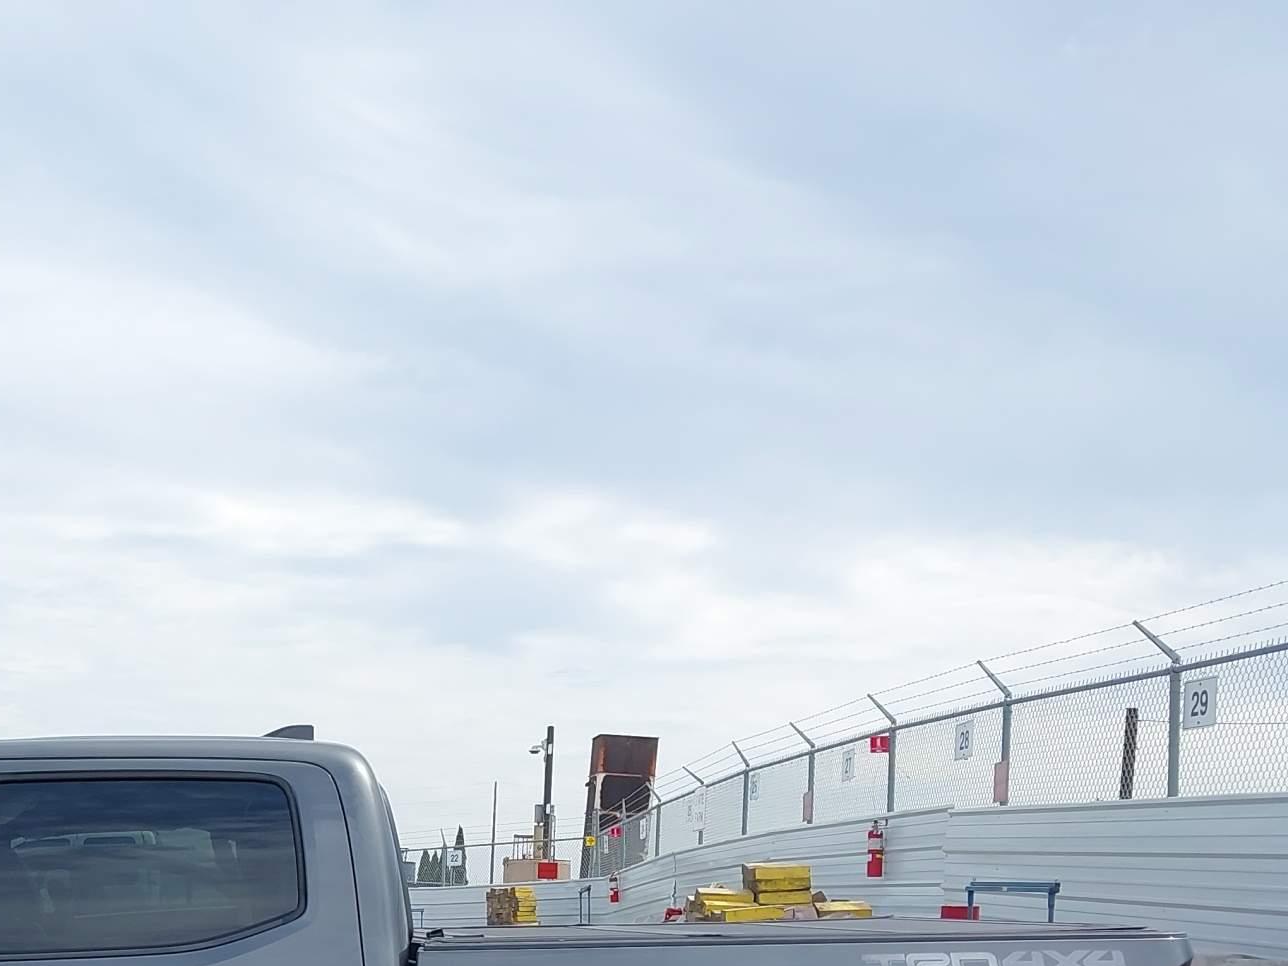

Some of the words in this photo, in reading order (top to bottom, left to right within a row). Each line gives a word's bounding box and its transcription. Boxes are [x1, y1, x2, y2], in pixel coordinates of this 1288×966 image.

[1191, 690, 1208, 717] 29
[959, 730, 969, 750] 28
[450, 854, 459, 863] 22
